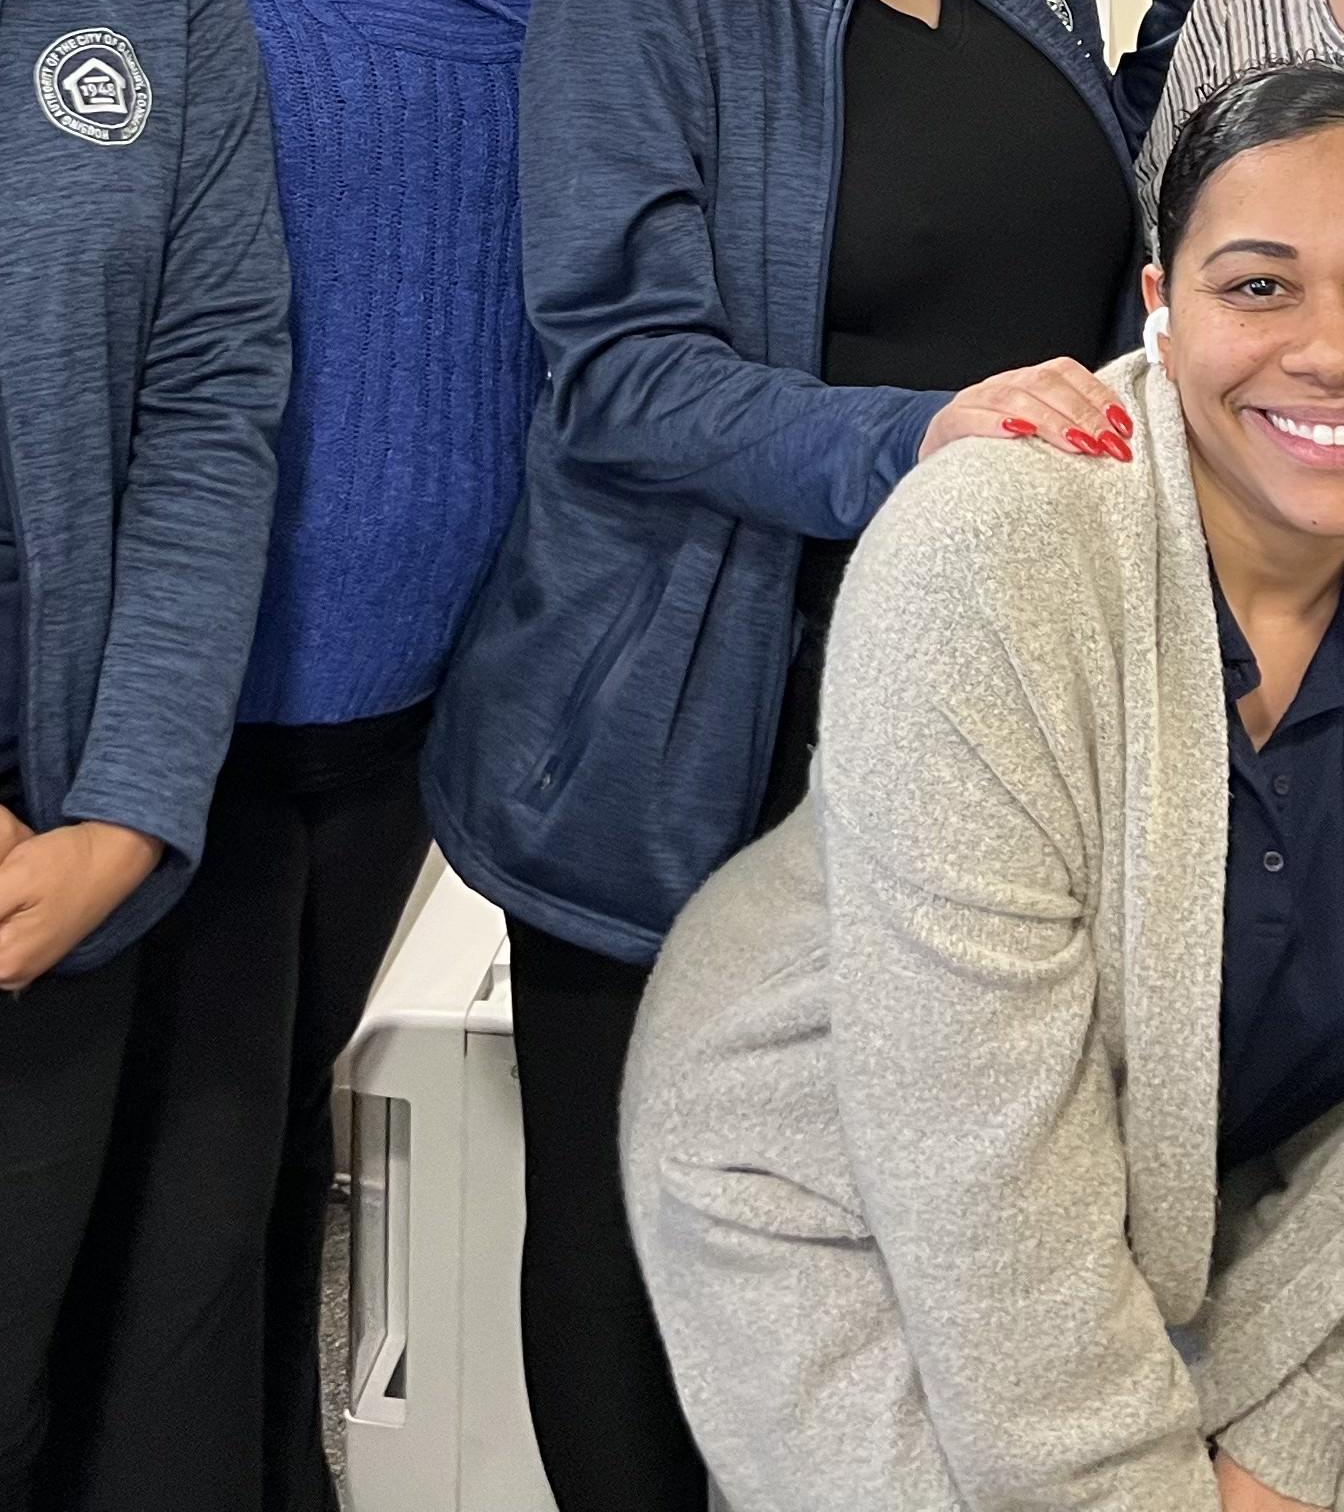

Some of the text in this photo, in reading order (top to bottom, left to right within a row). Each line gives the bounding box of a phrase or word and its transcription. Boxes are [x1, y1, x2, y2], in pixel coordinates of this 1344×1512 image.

[57, 38, 78, 55] THE
[76, 33, 102, 46] CITY
[104, 34, 118, 47] OF
[46, 53, 60, 67] OF
[41, 66, 66, 118] AUTHORITY
[60, 115, 109, 140] HOUSING
